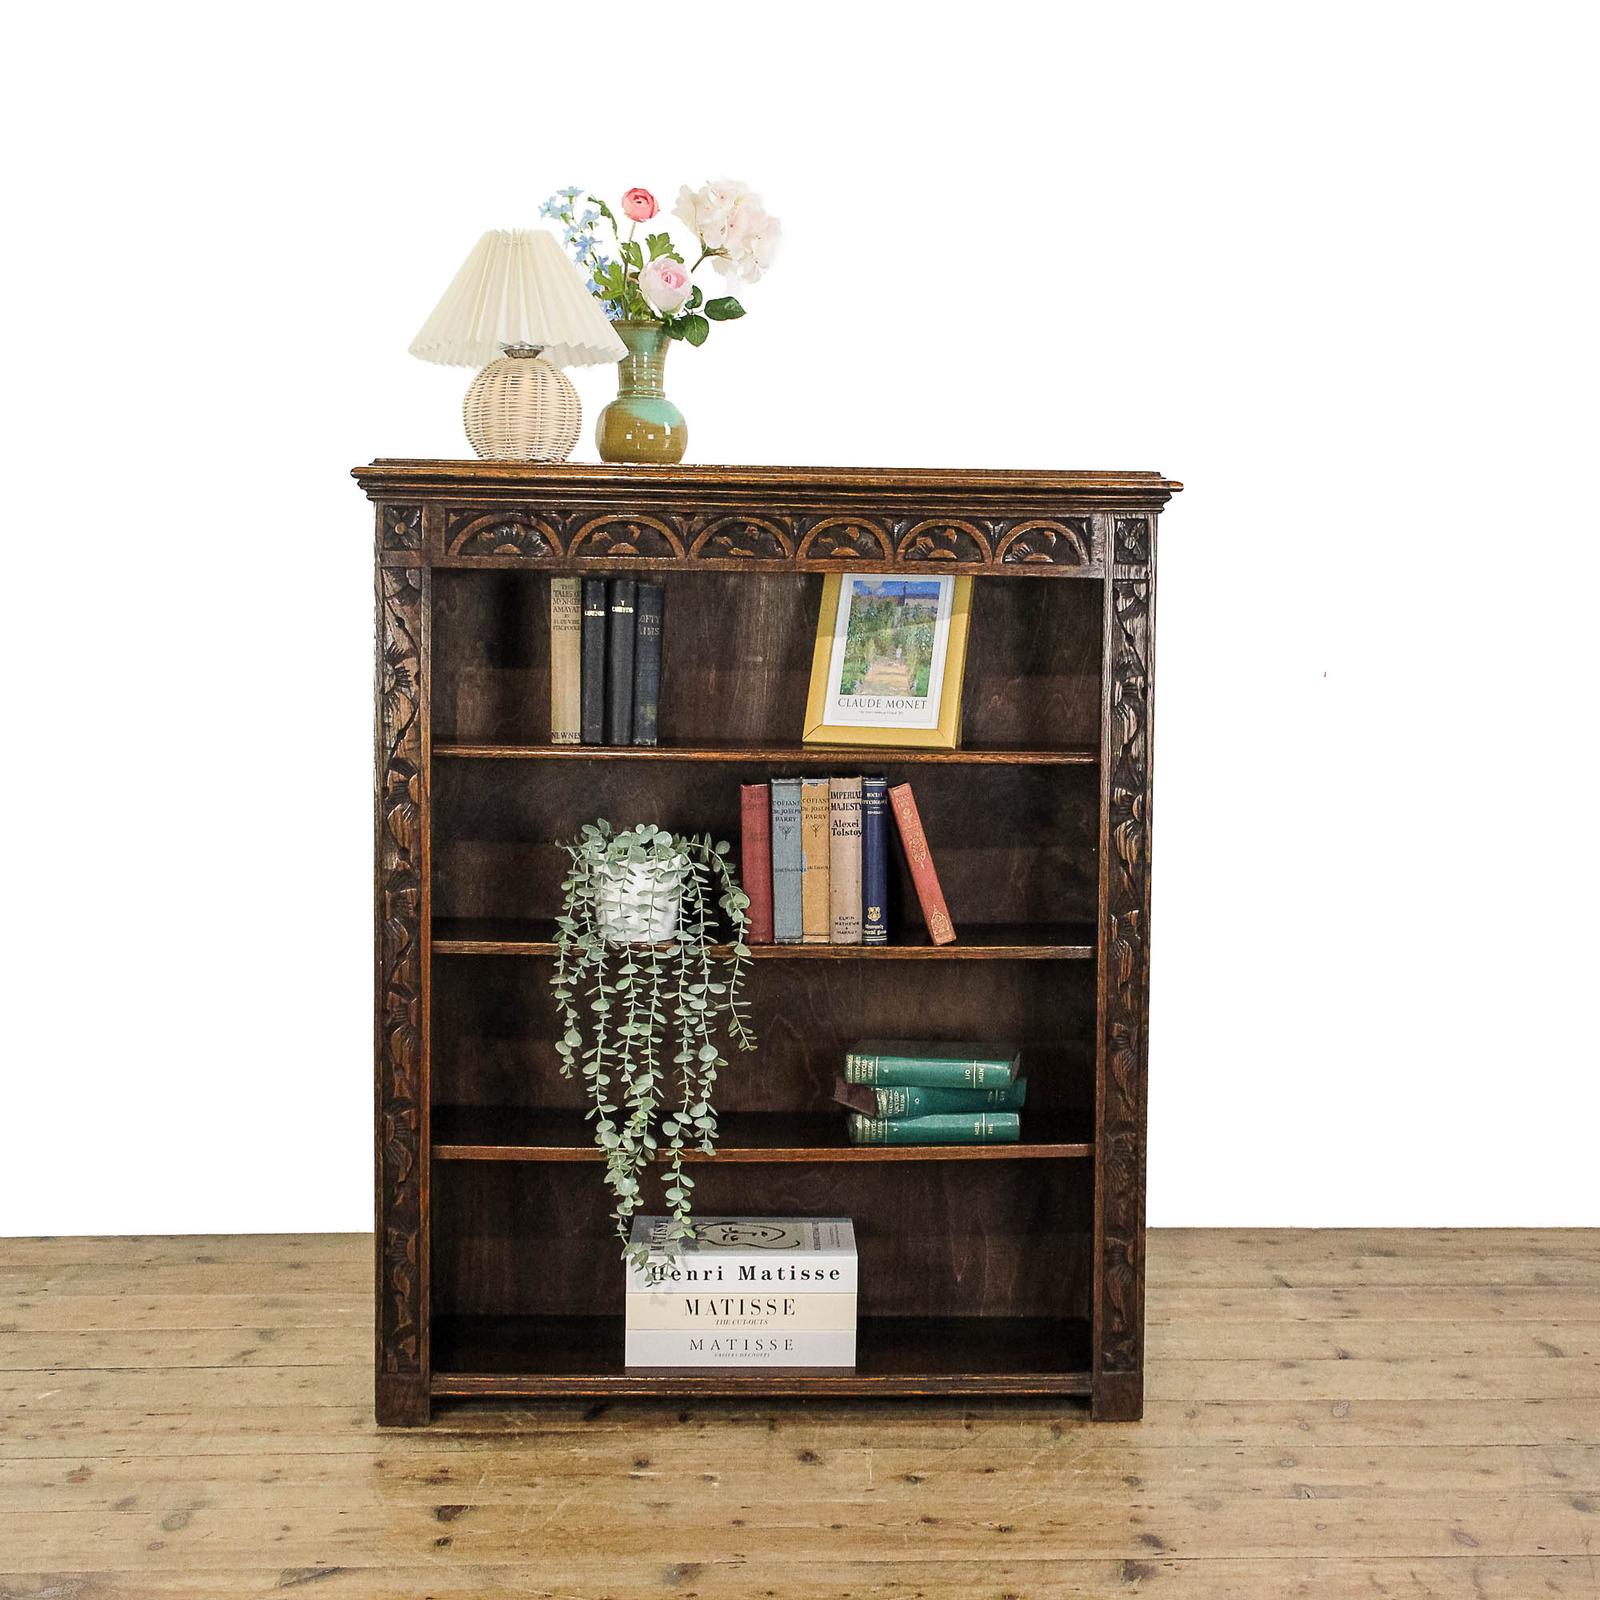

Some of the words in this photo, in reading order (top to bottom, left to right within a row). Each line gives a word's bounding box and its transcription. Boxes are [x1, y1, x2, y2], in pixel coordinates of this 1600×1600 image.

[553, 590, 573, 598] TALES
[837, 697, 882, 709] CLAUDE
[885, 699, 928, 710] MONET
[551, 731, 581, 740] NEWNES
[831, 802, 862, 812] MAJESTY
[832, 819, 860, 828] Alexei
[831, 827, 863, 838] Tolstoy
[651, 1265, 724, 1282] Henri
[738, 1265, 841, 1282] Matisse
[684, 1298, 796, 1316] MATISSE
[689, 1338, 794, 1351] MATISSE
